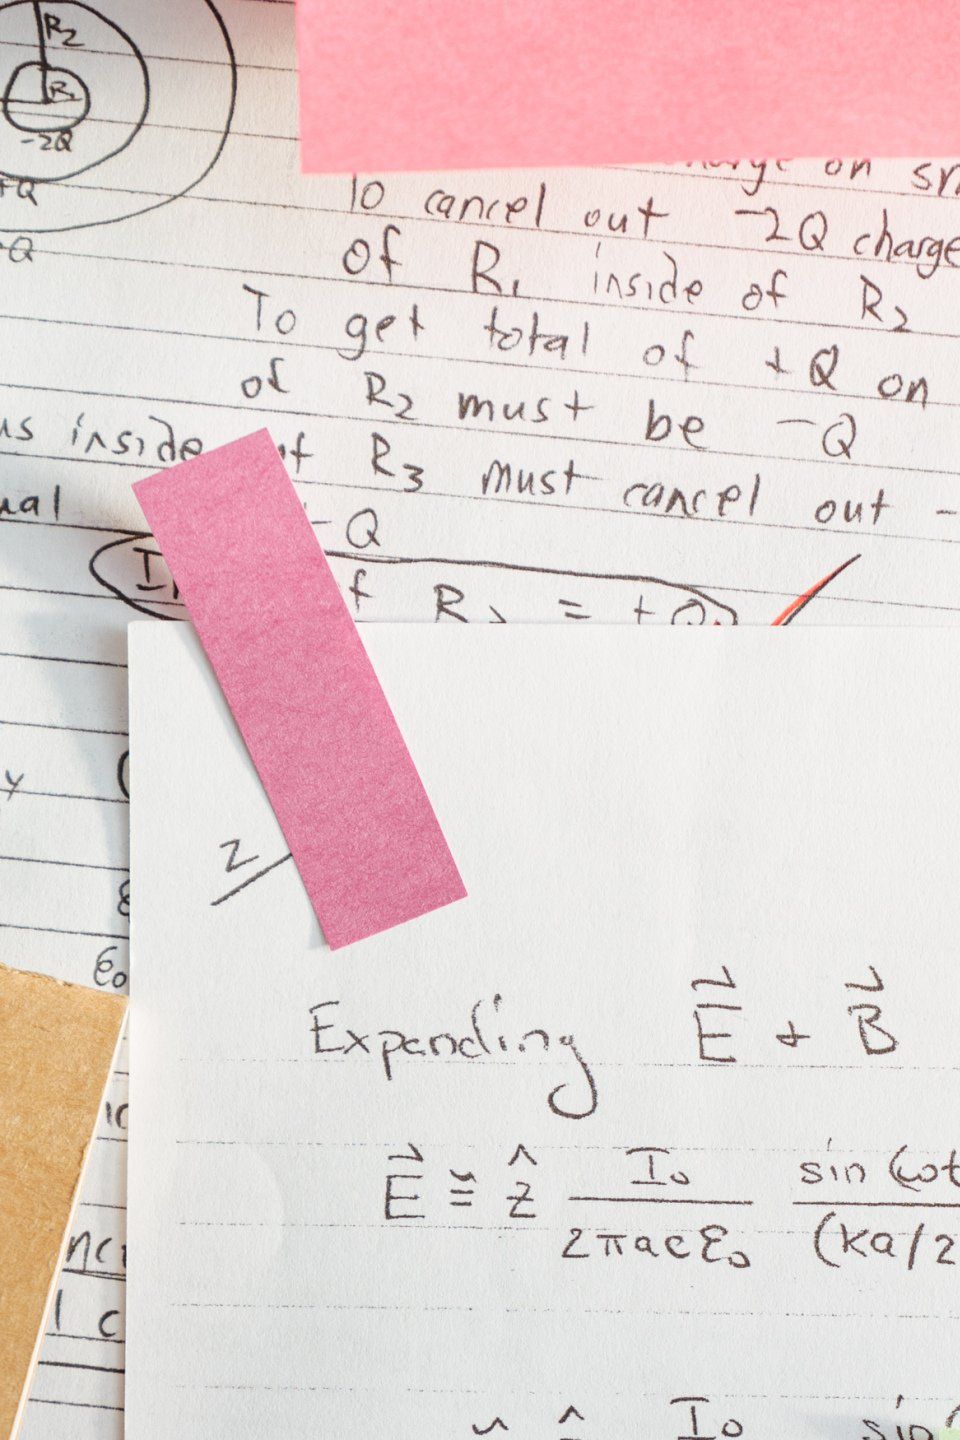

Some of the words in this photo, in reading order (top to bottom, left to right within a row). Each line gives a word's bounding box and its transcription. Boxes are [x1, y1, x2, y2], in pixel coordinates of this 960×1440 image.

[424, 182, 546, 228] cancel
[584, 197, 670, 238] out
[342, 224, 402, 282] of
[594, 232, 703, 304] inside
[742, 269, 788, 310] of
[243, 284, 297, 335] To
[338, 303, 425, 360] get
[484, 306, 590, 356] total
[643, 332, 696, 382] of
[877, 371, 930, 405] on
[241, 357, 289, 399] of
[458, 388, 595, 426] must
[644, 398, 706, 451] be
[71, 412, 203, 463] inside
[482, 458, 605, 497] must
[622, 473, 761, 520] cancel
[815, 488, 887, 525] out
[308, 992, 598, 1119] Expanding
